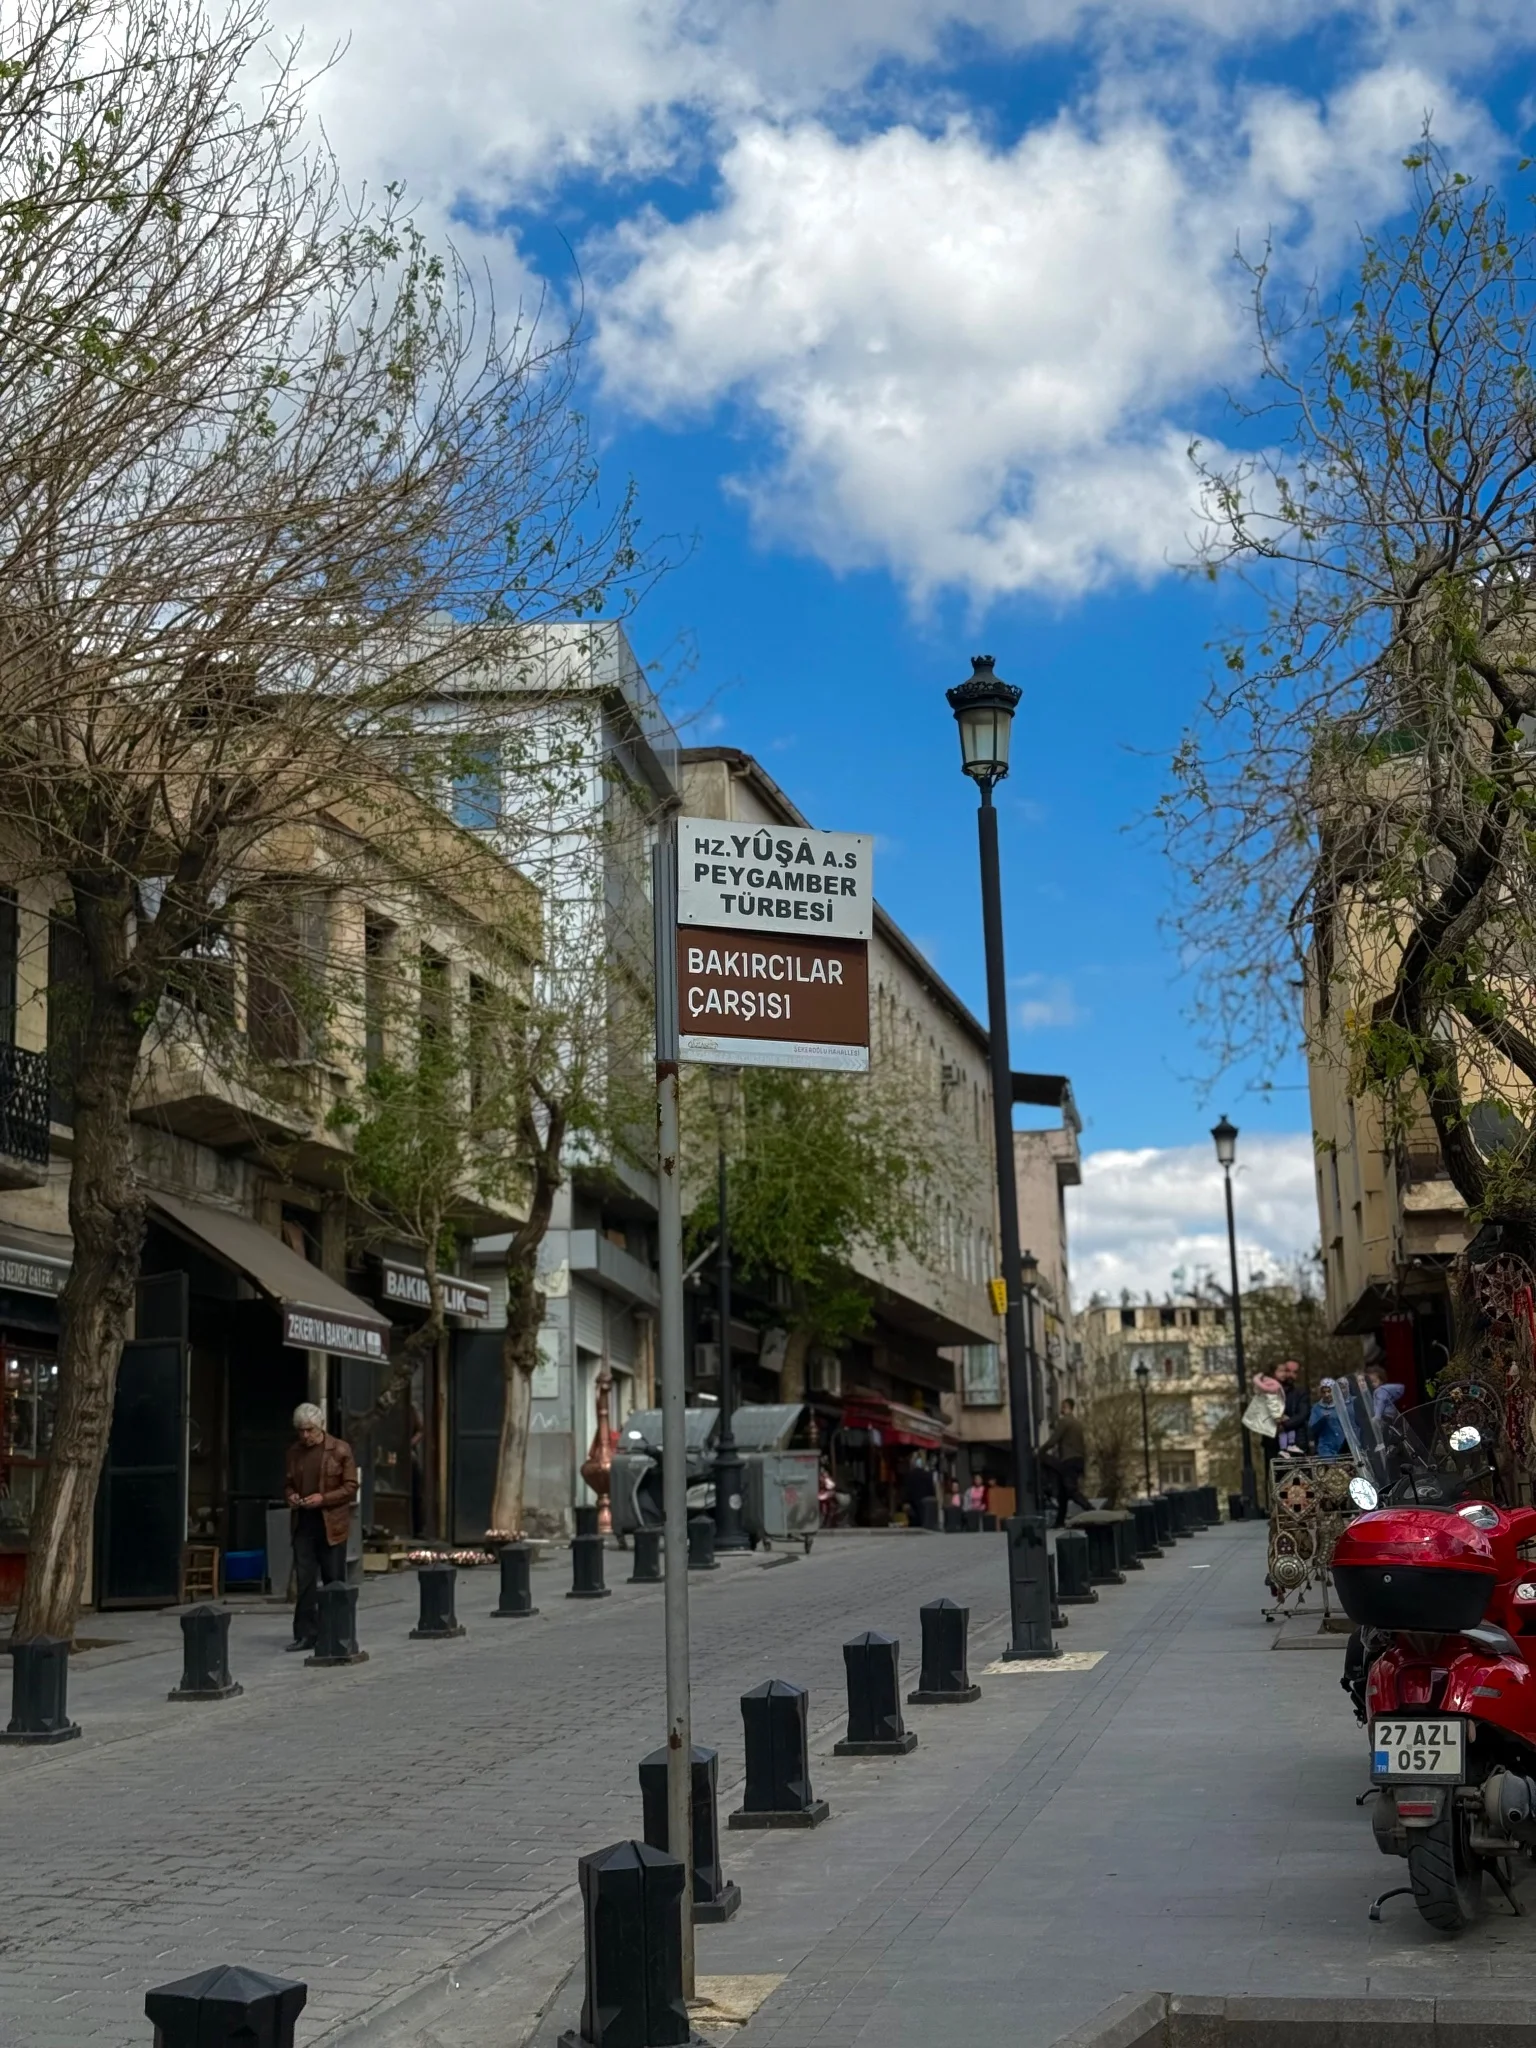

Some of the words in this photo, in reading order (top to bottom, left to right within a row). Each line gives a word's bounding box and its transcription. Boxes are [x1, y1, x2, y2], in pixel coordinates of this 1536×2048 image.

[822, 851, 858, 869] A.S
[694, 863, 857, 897] PEYGAMBER
[720, 891, 833, 923] TÜRBESİ
[688, 947, 843, 985] BAKIRCILAR
[687, 986, 791, 1021] ÇARŞISI
[325, 1321, 368, 1352] BAKIRCILIK
[1380, 1724, 1407, 1745] 27
[1413, 1724, 1457, 1745] AZL
[1376, 1764, 1387, 1772] TR
[1398, 1750, 1441, 1770] 057
